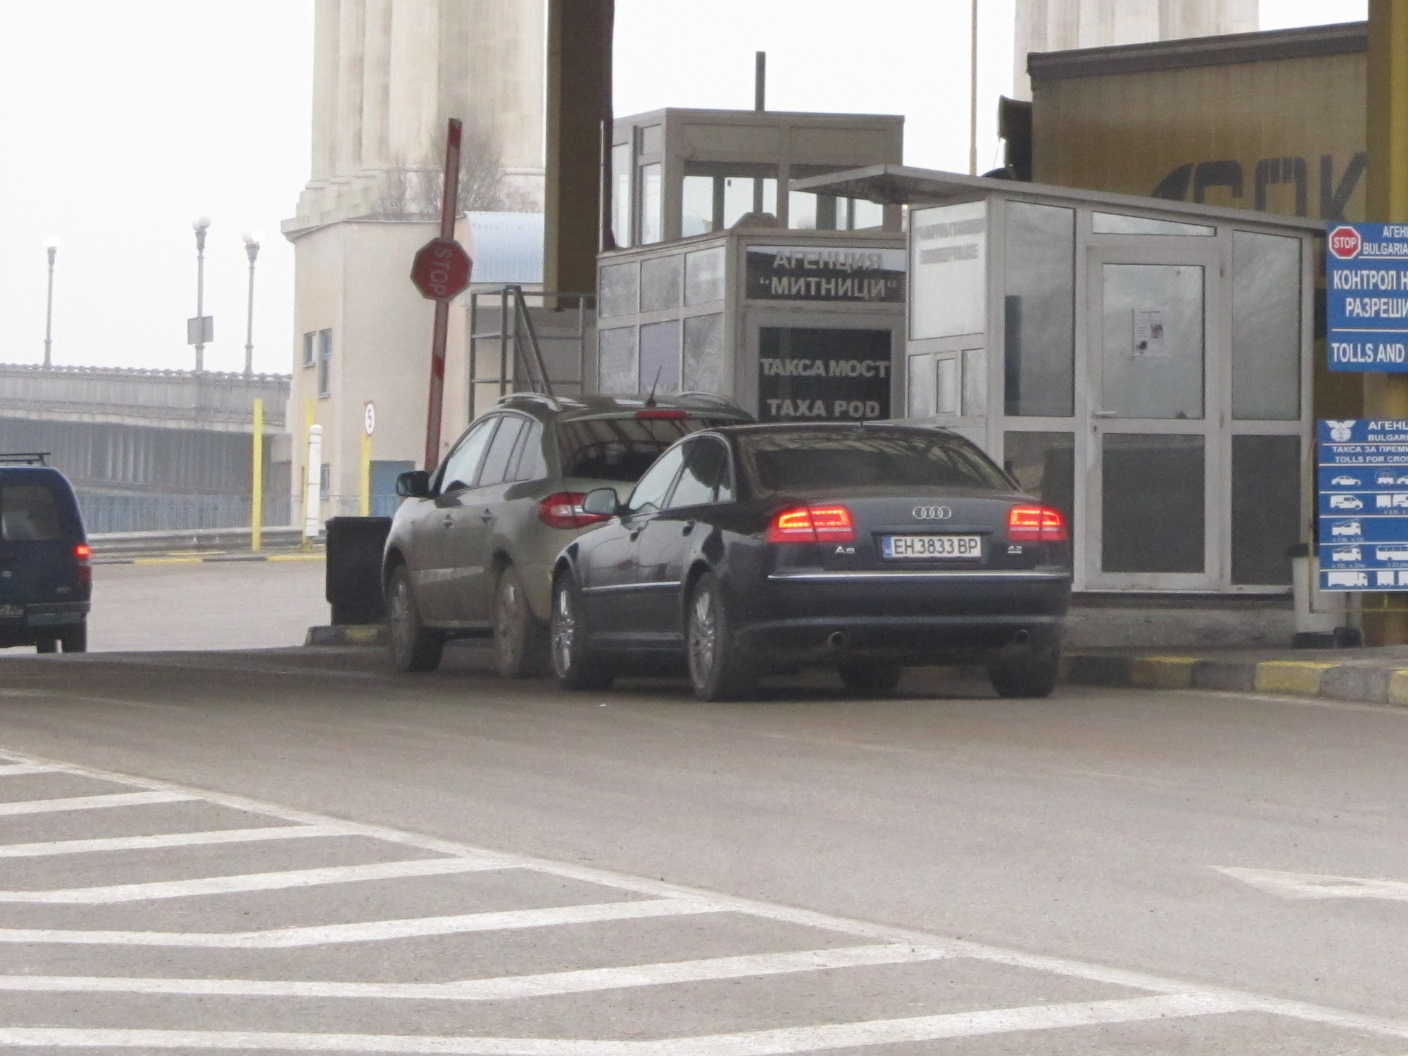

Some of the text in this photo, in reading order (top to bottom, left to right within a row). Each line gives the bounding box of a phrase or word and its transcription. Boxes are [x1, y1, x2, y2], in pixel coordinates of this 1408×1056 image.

[1333, 237, 1357, 249] STOP
[773, 250, 883, 273] АГЕНЦИЯ
[1333, 270, 1397, 290] КОНТРОЛ
[1332, 343, 1374, 362] TOLLS
[1377, 343, 1405, 363] AND
[761, 359, 891, 378] ТАКСА МОСТ
[767, 399, 881, 418] TAXA POD
[1335, 455, 1364, 463] TOLLS
[1366, 455, 1385, 463] FOR
[894, 538, 978, 555] EH 3833 BP
